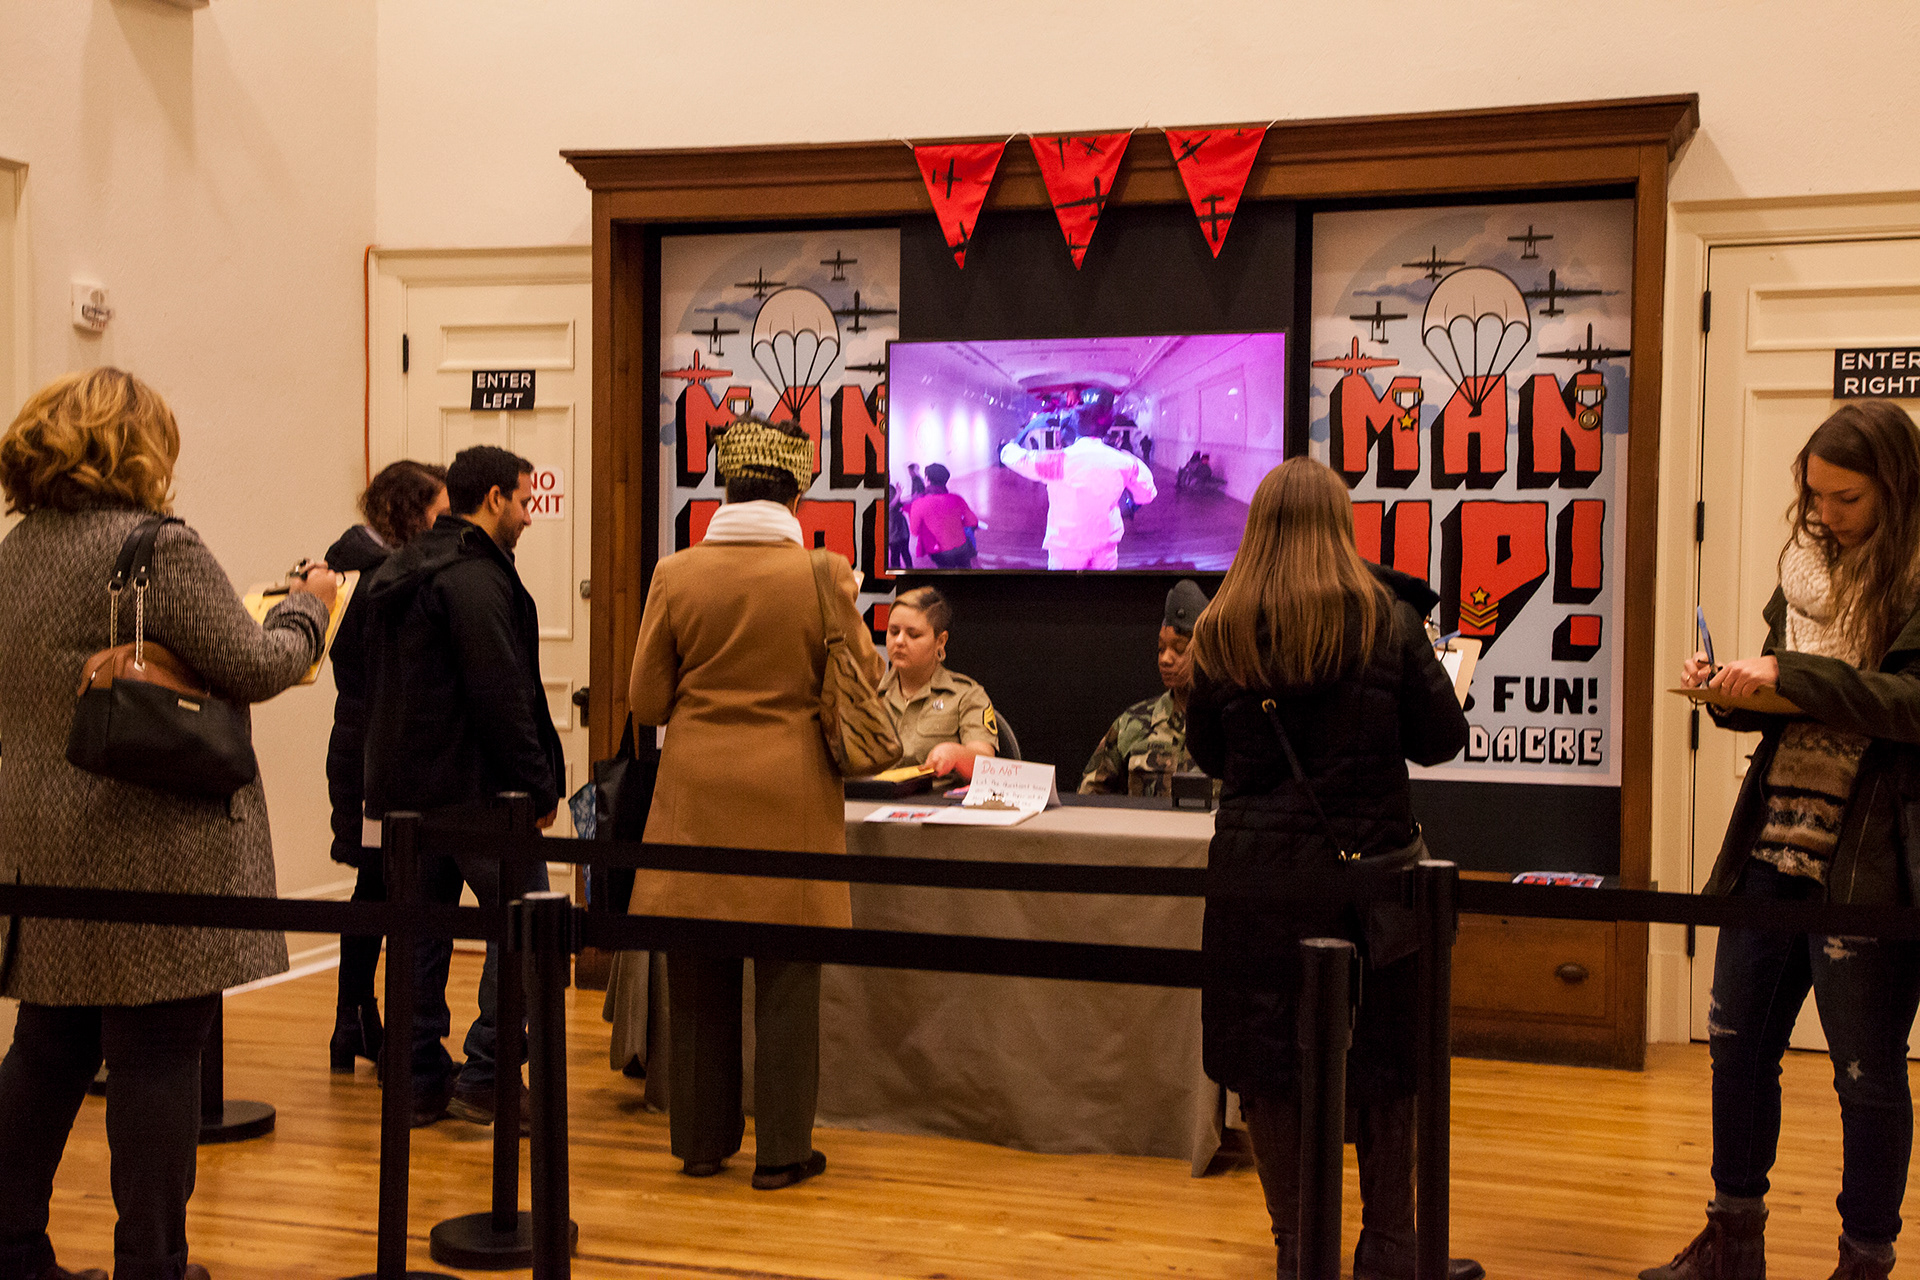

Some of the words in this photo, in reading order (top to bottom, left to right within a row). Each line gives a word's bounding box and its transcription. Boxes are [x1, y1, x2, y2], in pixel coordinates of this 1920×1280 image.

[1841, 351, 1920, 370] ENTER
[476, 372, 532, 389] ENTER
[1843, 376, 1920, 394] RIGHT
[482, 392, 524, 409] LEFT
[1330, 373, 1604, 490] MAN
[531, 494, 564, 513] XIT
[1493, 676, 1598, 714] FUN!
[1464, 725, 1602, 766] DACRE
